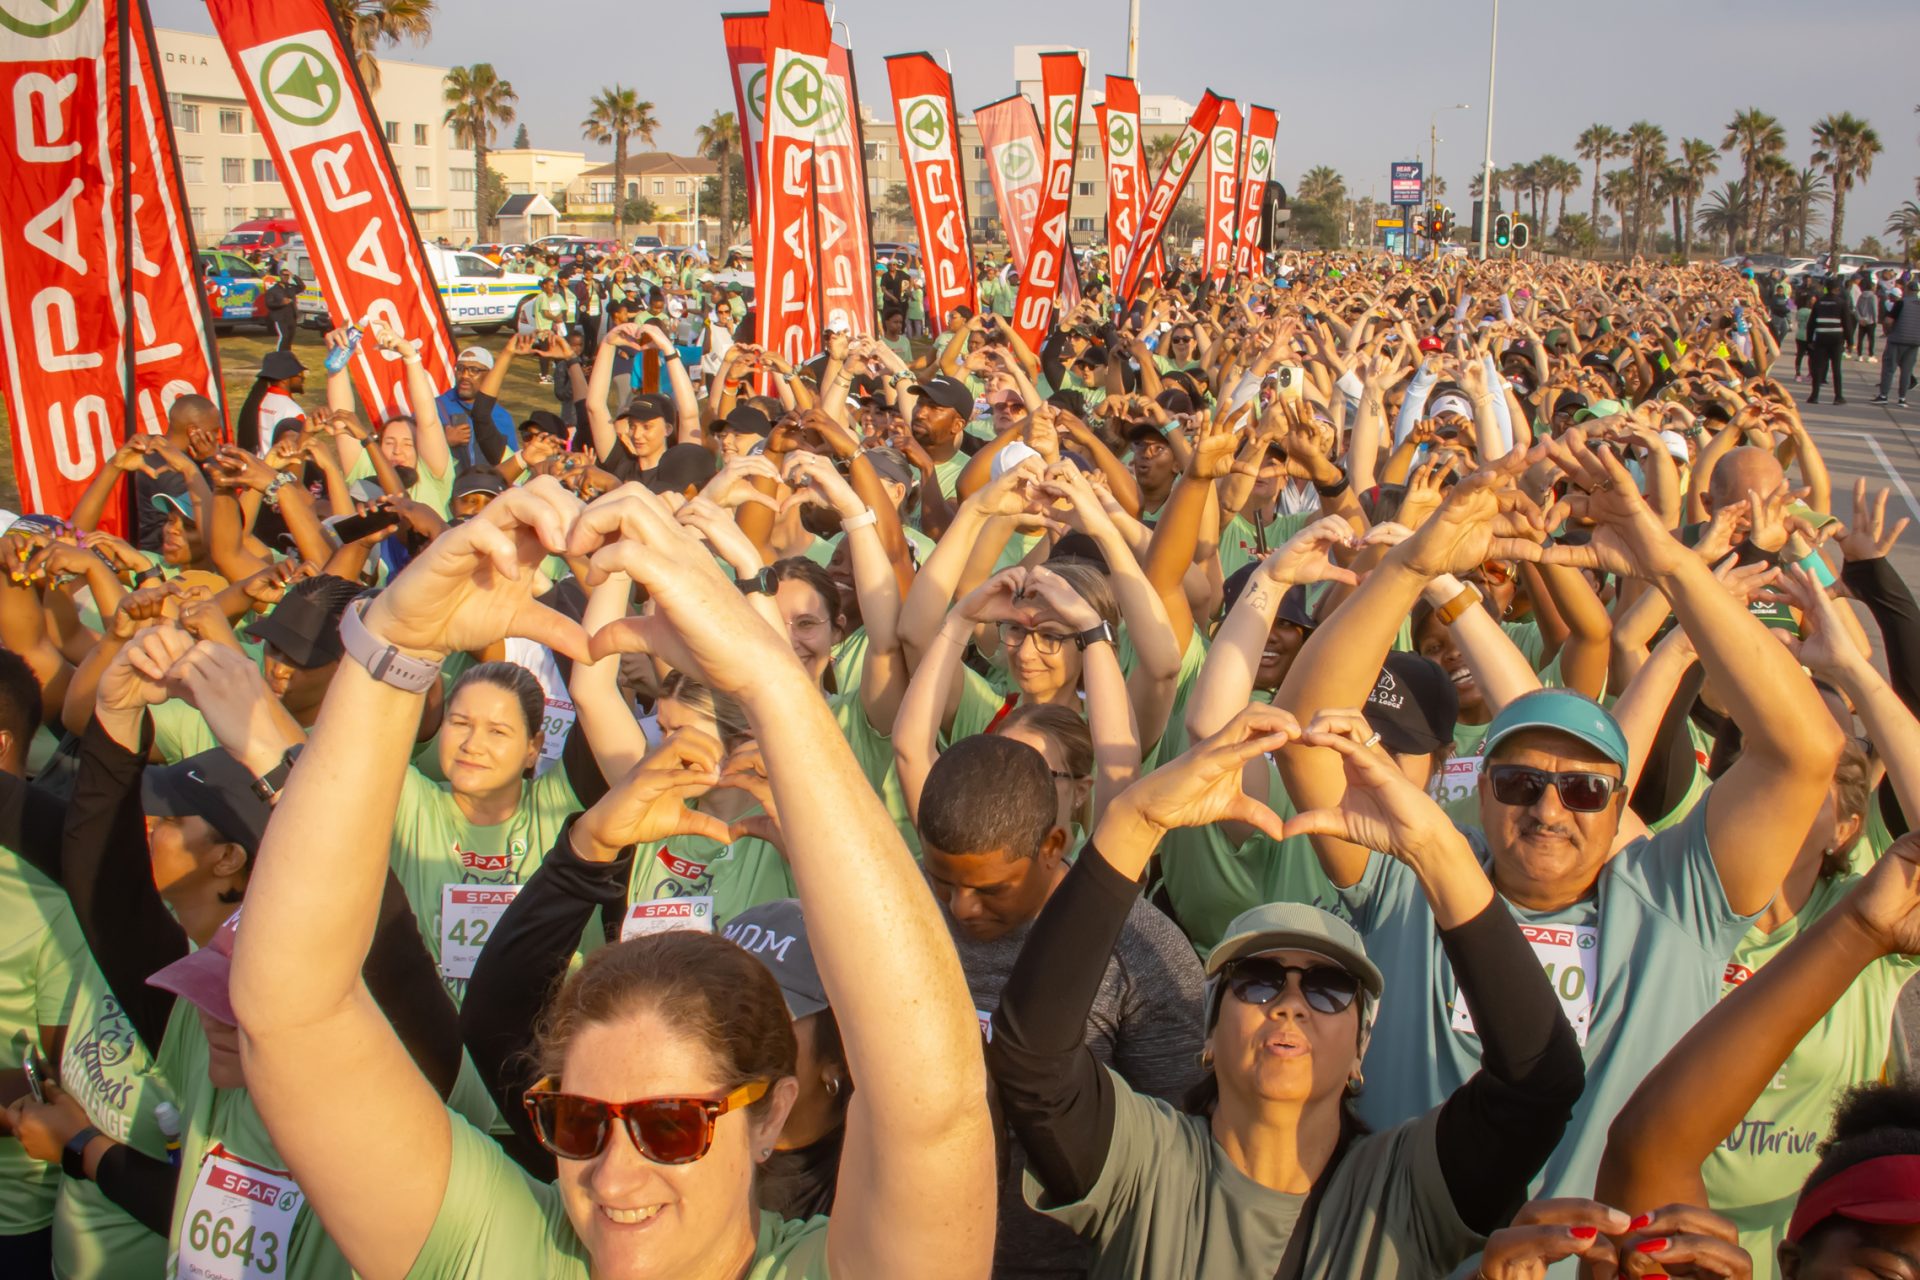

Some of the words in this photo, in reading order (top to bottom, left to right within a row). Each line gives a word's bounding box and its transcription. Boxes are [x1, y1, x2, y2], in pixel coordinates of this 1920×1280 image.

[1112, 167, 1134, 276] PAR
[1238, 184, 1260, 272] PAR
[926, 164, 965, 327] PAR
[13, 72, 117, 481] SPAR
[459, 306, 505, 316] POLICE
[1444, 763, 1472, 772] PAR
[646, 905, 690, 916] SPAR
[1523, 928, 1571, 944] PAR
[223, 1174, 278, 1202] SPAR
[189, 1209, 279, 1274] 6643
